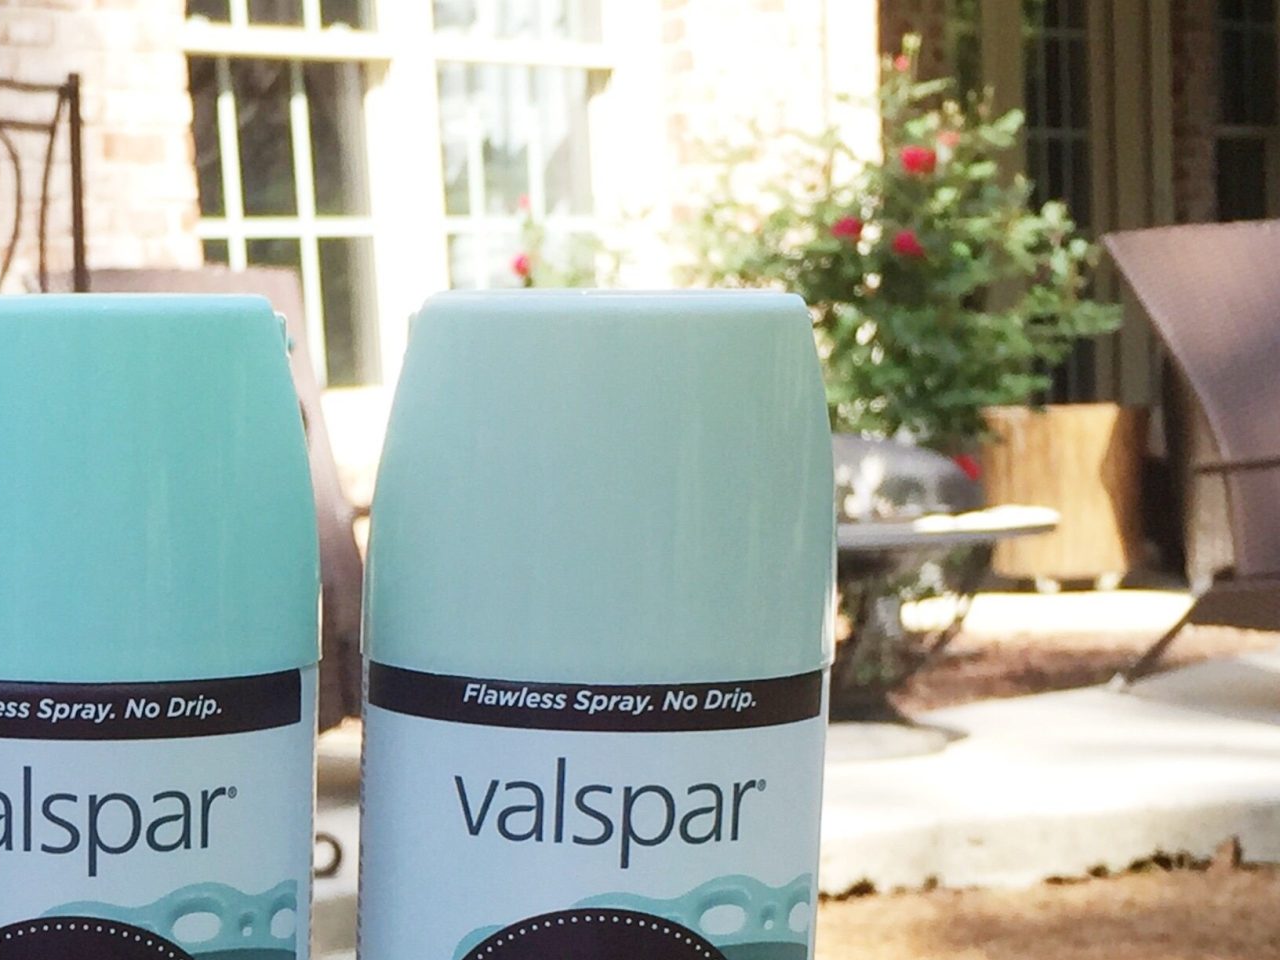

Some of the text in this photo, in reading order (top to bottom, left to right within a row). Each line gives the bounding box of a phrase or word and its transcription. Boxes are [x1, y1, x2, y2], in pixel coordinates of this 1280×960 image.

[37, 699, 116, 723] Spray.
[124, 698, 160, 719] No
[167, 695, 223, 717] Drip.
[463, 683, 757, 714] Flawless Spray. No Drip.
